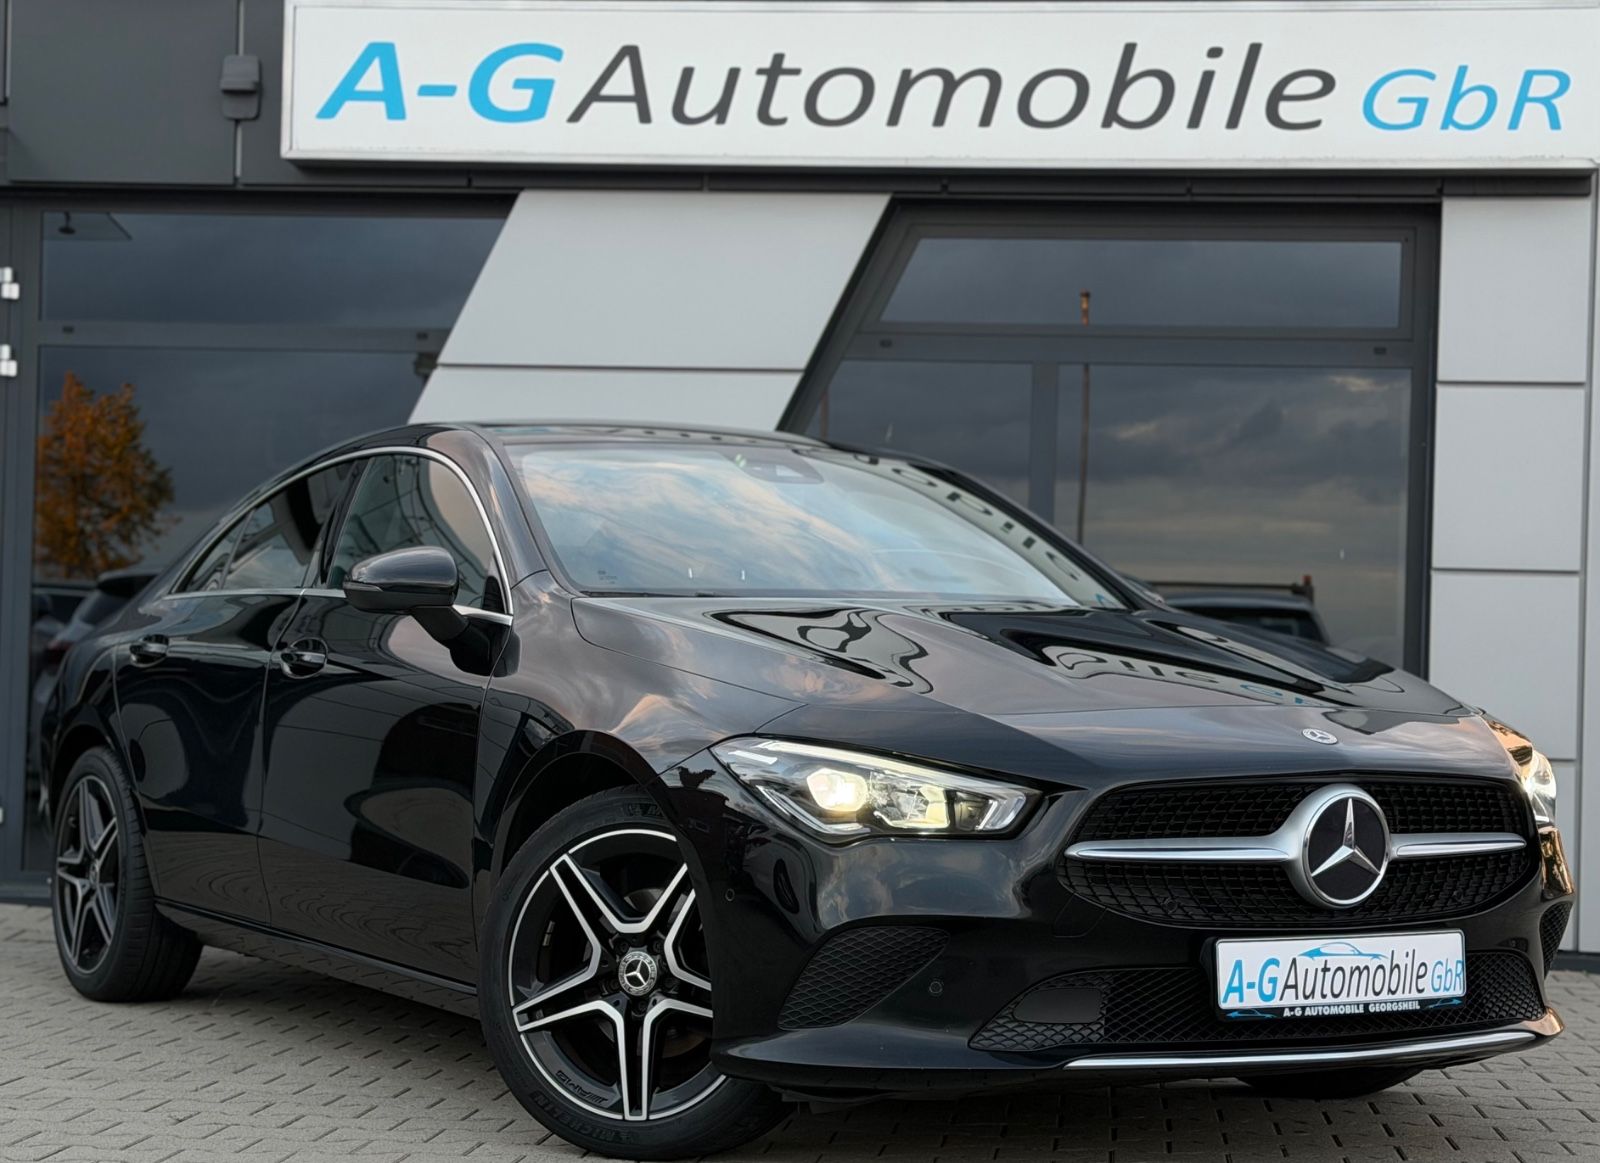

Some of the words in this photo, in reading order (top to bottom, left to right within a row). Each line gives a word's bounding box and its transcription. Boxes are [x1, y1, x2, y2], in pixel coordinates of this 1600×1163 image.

[316, 42, 564, 123] A-G
[566, 42, 1336, 131] Automobile
[1362, 65, 1572, 131] GbR
[1222, 957, 1281, 1004] A-G
[1279, 949, 1429, 1002] Automobile
[1431, 958, 1464, 992] GbR
[1283, 1007, 1302, 1017] A-G
[1304, 1003, 1364, 1016] AUTOMOBILE
[1368, 1000, 1420, 1012] GEORGSHEIL
